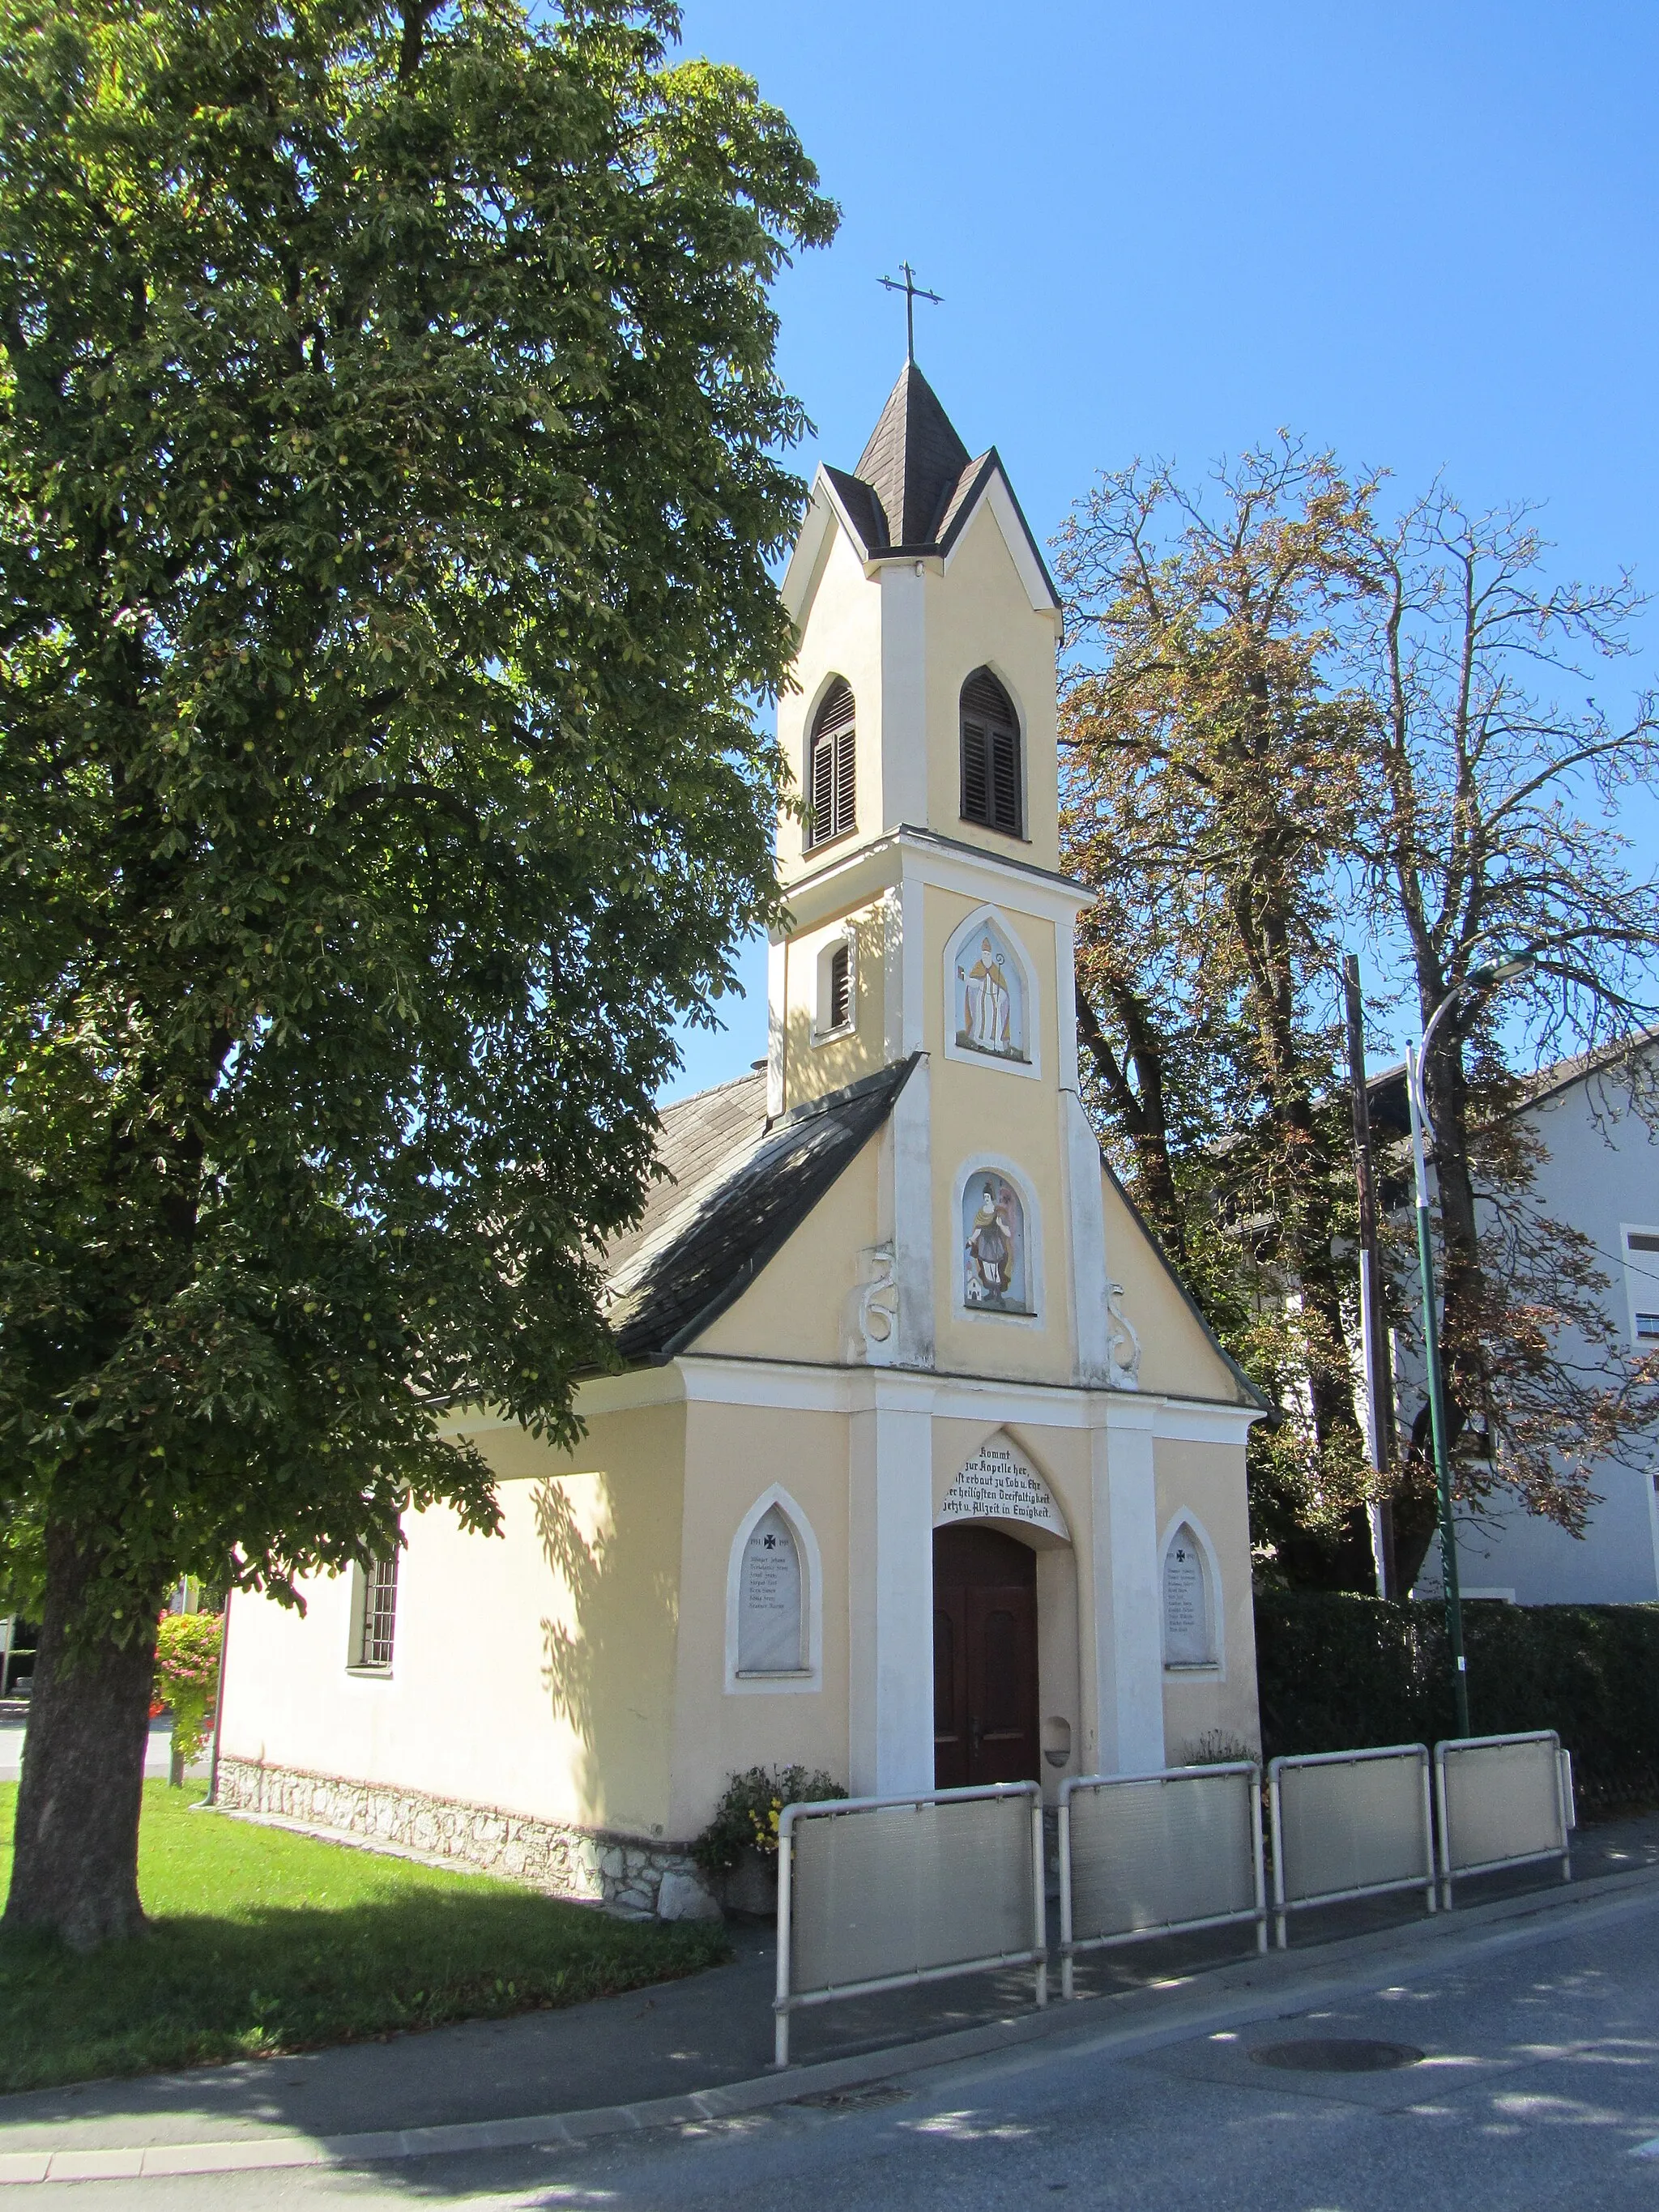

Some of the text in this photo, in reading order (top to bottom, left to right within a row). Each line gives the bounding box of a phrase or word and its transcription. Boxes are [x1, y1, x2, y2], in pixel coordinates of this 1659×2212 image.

[979, 1447, 1010, 1460] Kommt
[965, 1460, 1030, 1477] zur Kapelle her,
[966, 1474, 993, 1484] erbaut
[995, 1478, 1004, 1488] zu
[1005, 1477, 1019, 1488] Lob
[1021, 1481, 1027, 1489] u.
[1028, 1479, 1041, 1491] Ehr
[947, 1486, 1050, 1504] er heiligsten Dreifaltigkeit
[943, 1498, 1051, 1519] jetzt u. Allzeit in Ewigkeit.
